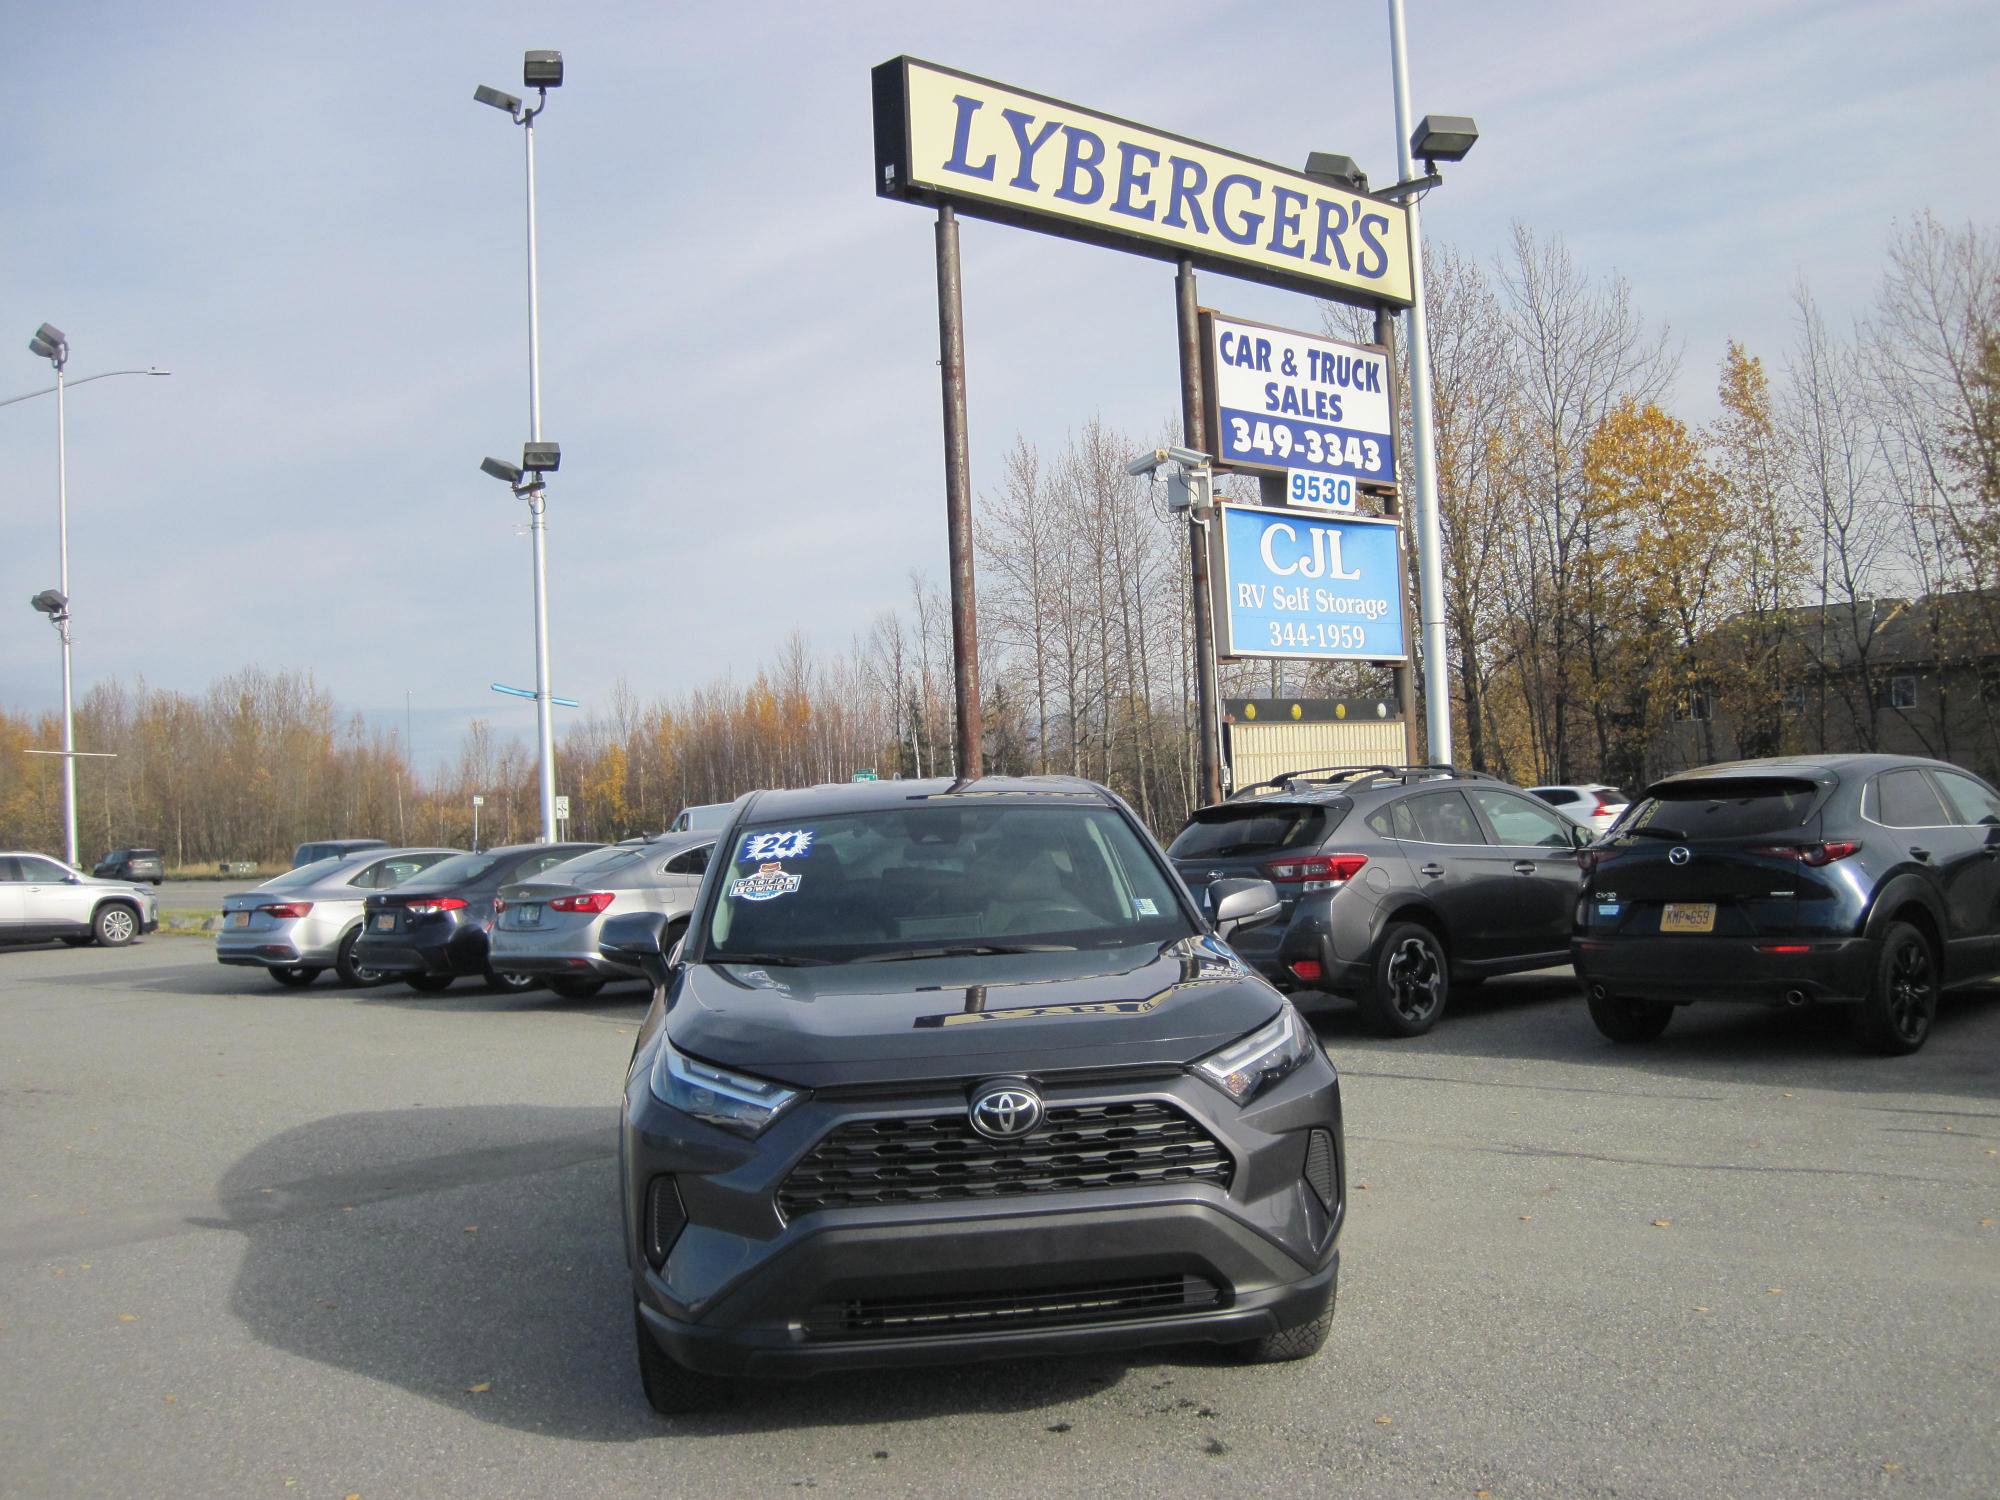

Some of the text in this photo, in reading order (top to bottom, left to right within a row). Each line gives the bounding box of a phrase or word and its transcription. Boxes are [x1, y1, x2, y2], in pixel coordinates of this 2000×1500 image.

[942, 94, 1389, 279] LYBERGER'S
[1219, 331, 1381, 393] CAR & TRUCK
[1264, 381, 1343, 422] SALES
[1230, 417, 1382, 472] 349-3343
[1291, 473, 1351, 506] 9530
[1260, 523, 1361, 581] CJL
[1237, 583, 1388, 620] RV Self Storage
[1269, 621, 1366, 649] 344-1959
[757, 835, 799, 854] 24
[737, 876, 796, 888] CARFAX
